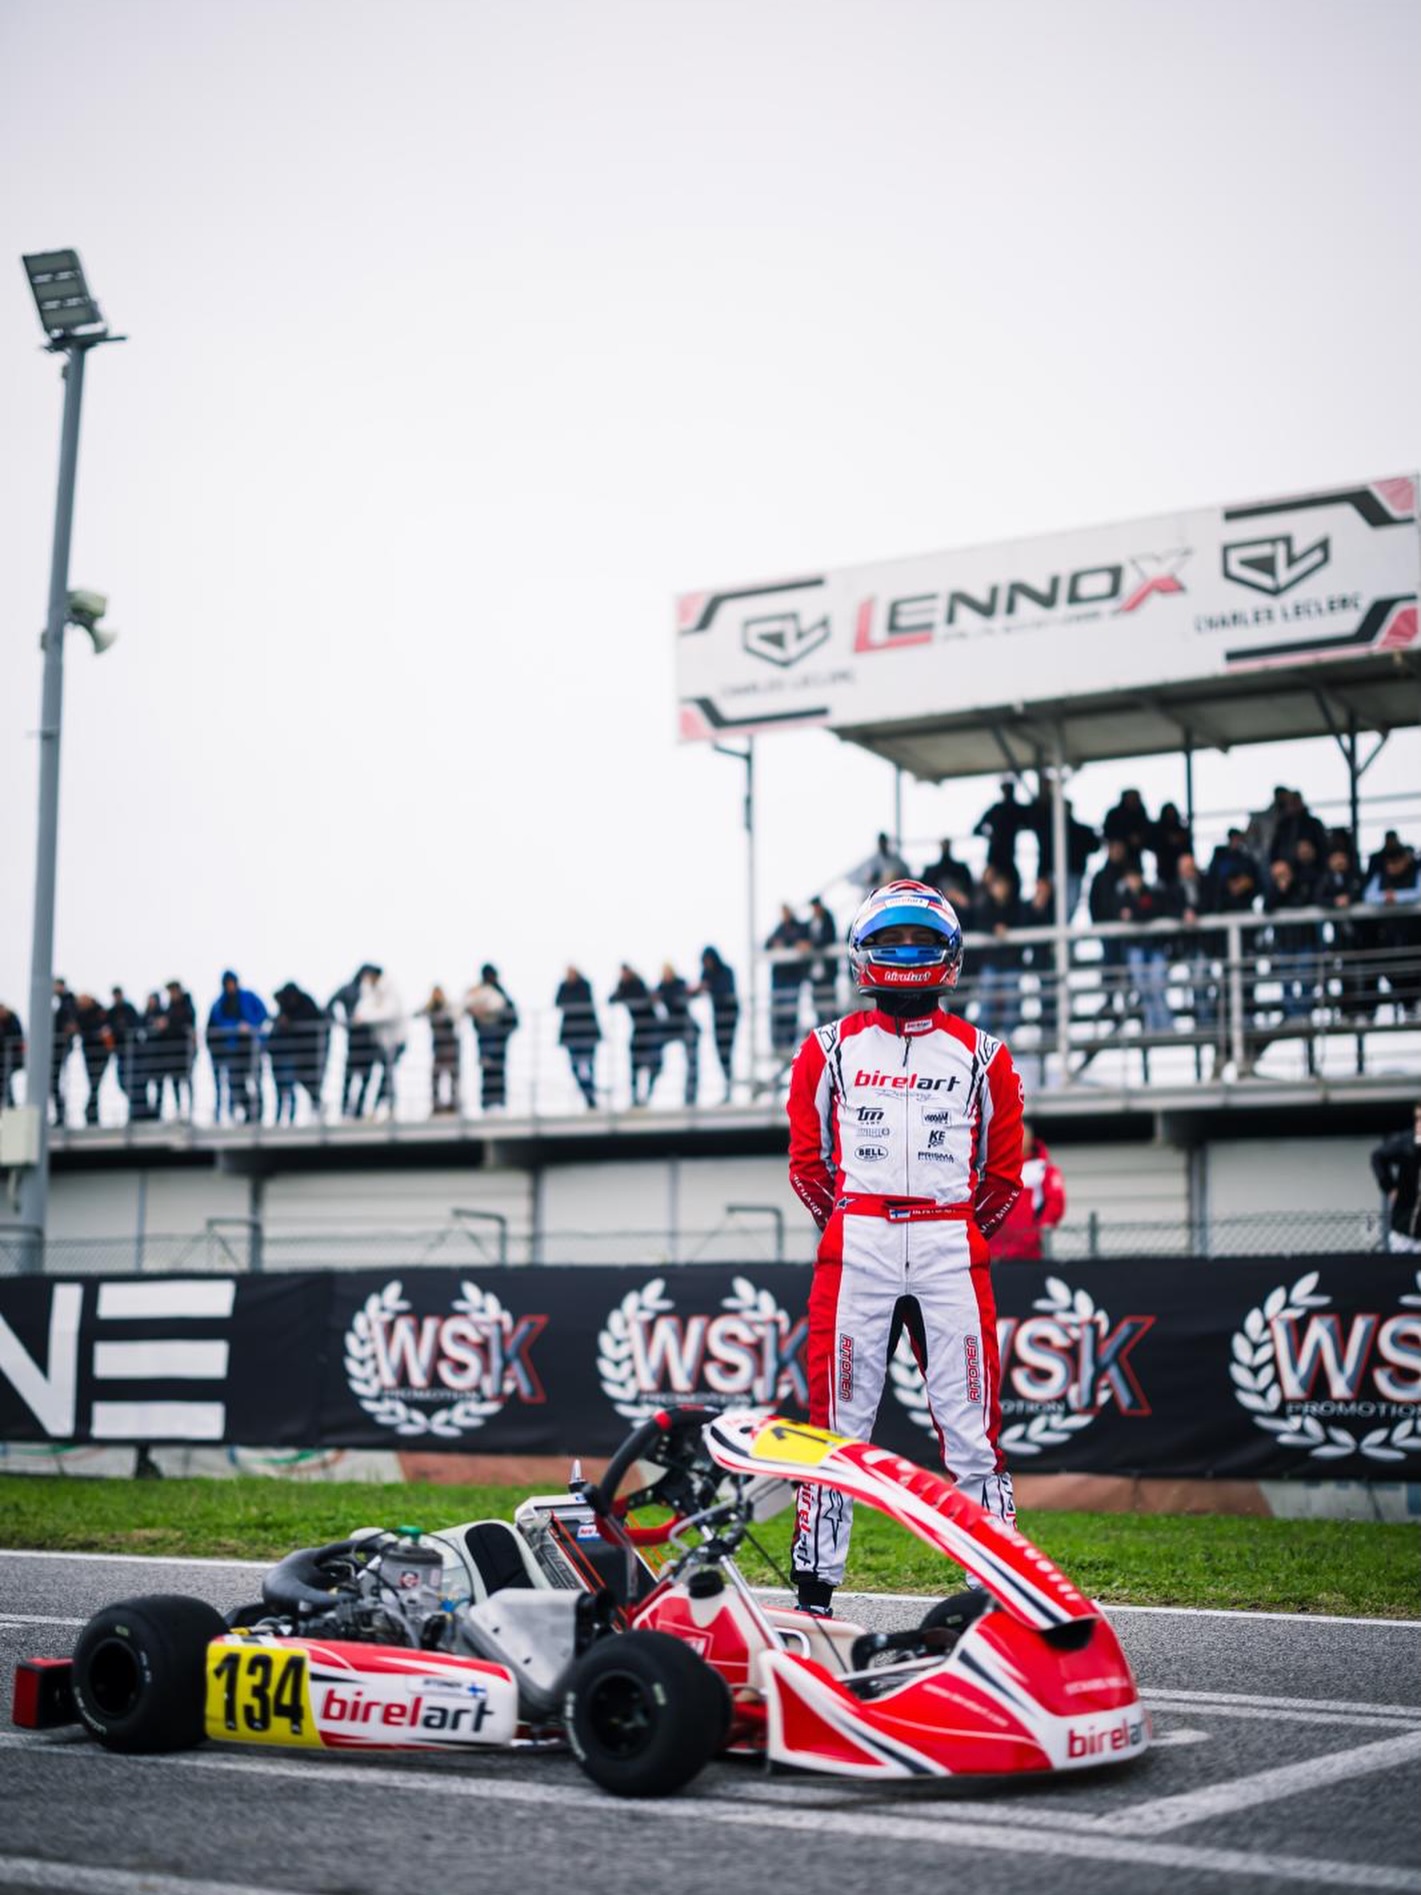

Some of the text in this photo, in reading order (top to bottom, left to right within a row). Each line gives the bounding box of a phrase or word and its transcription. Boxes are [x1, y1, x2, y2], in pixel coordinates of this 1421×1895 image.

[854, 546, 1194, 653] LENNOX
[854, 1069, 961, 1092] birelart
[859, 1148, 884, 1157] BELL
[371, 1314, 550, 1404] WSK
[627, 1313, 809, 1408] WSK
[996, 1315, 1158, 1417] SK
[1286, 1400, 1421, 1418] PROMOTIO
[213, 1652, 305, 1736] 134
[321, 1688, 494, 1733] birelart
[1068, 1718, 1144, 1758] birela
